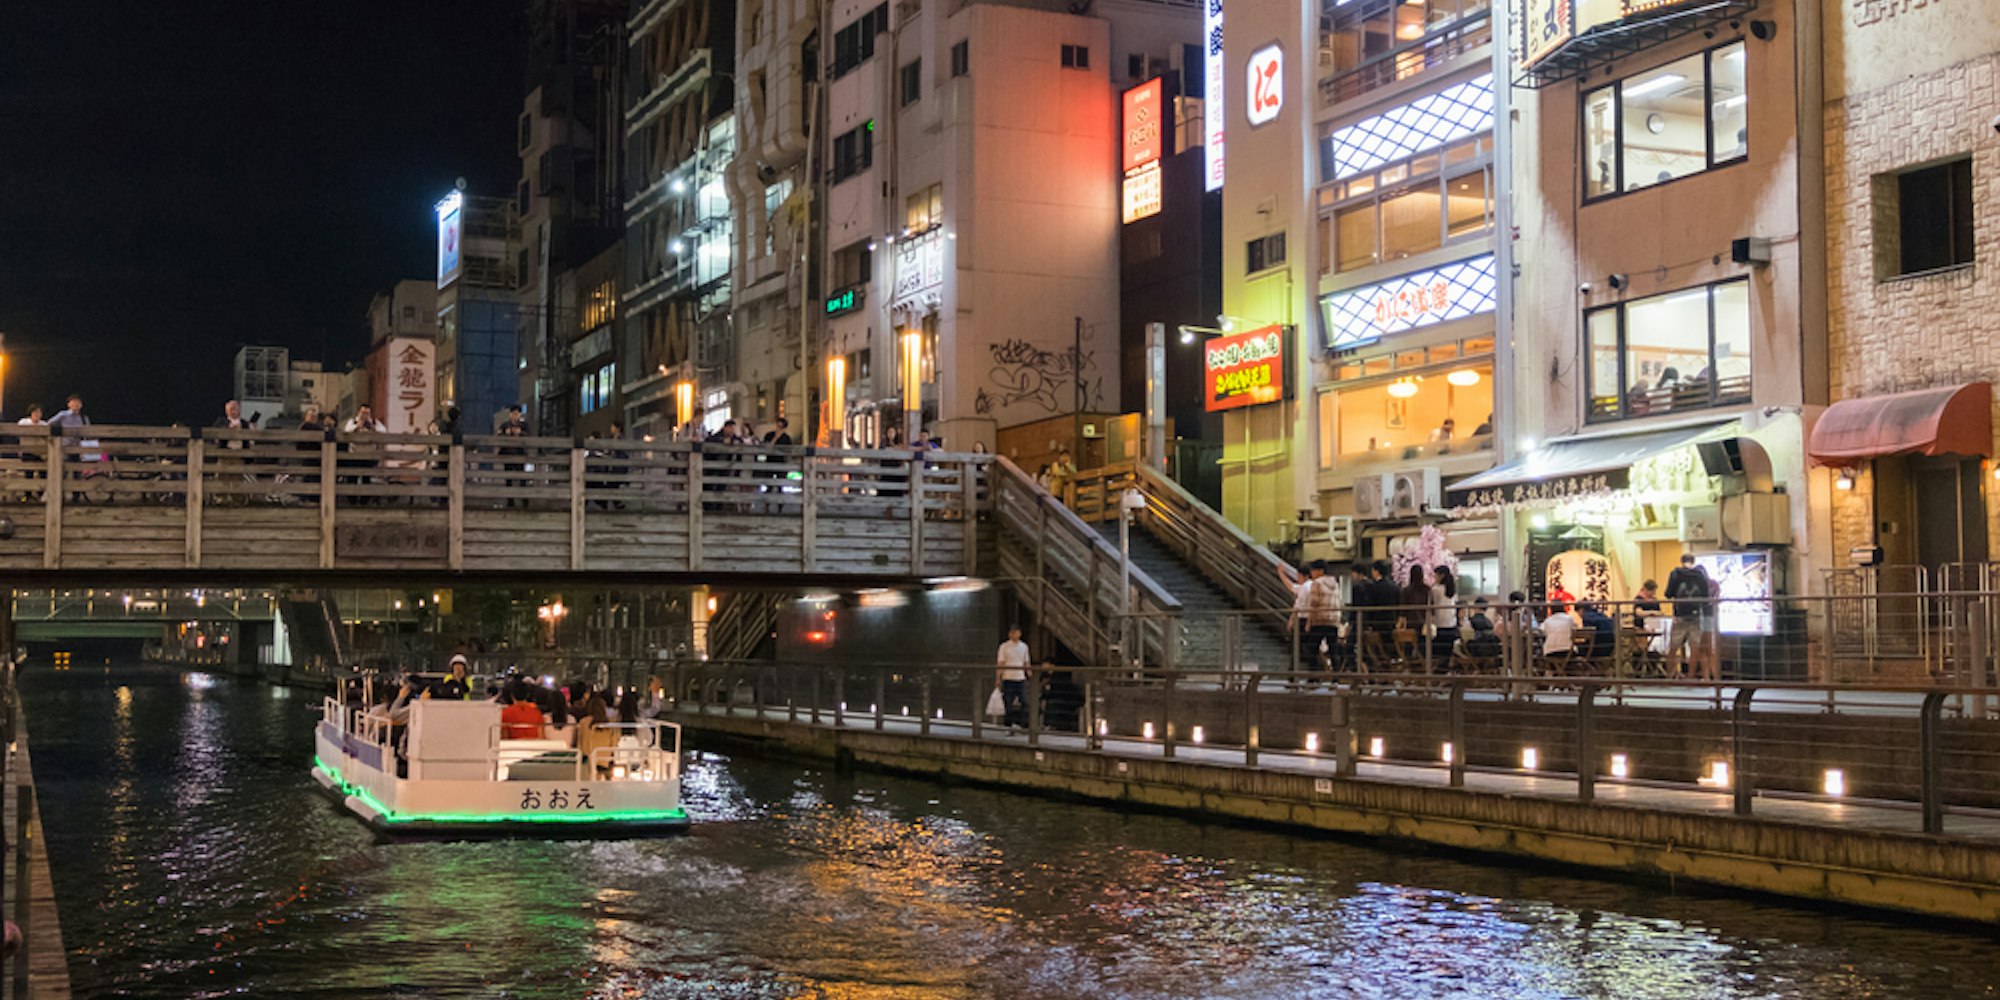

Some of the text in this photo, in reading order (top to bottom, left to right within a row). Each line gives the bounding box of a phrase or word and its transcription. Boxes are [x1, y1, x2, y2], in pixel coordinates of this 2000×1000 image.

[1254, 60, 1279, 113] に
[521, 787, 595, 810] おおえ
